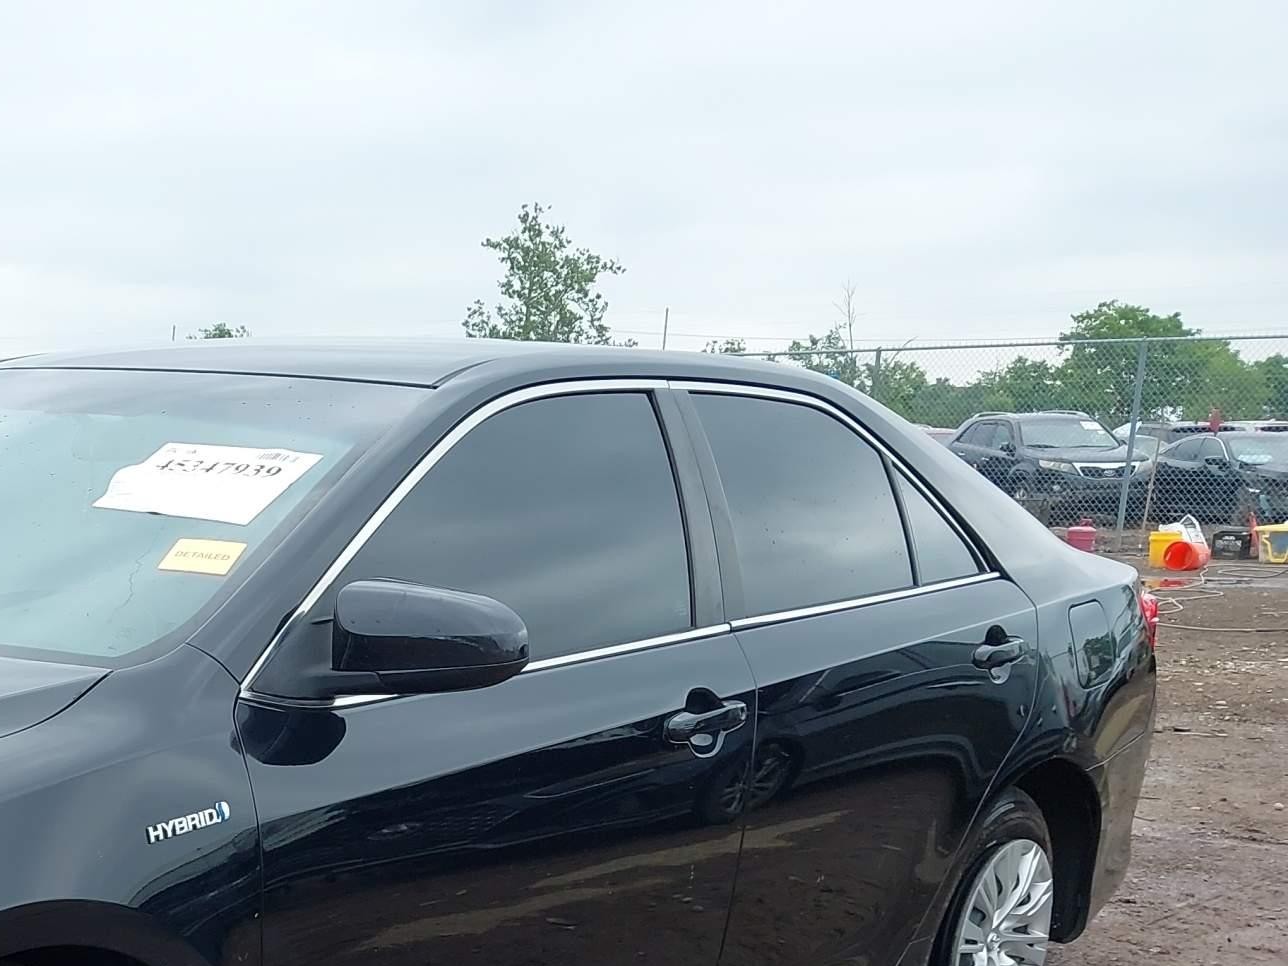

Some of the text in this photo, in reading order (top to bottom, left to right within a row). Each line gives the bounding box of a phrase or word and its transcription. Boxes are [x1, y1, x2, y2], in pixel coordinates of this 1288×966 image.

[155, 458, 283, 478] 45347939
[173, 550, 231, 561] DETAILED
[146, 808, 221, 844] HYBRID
